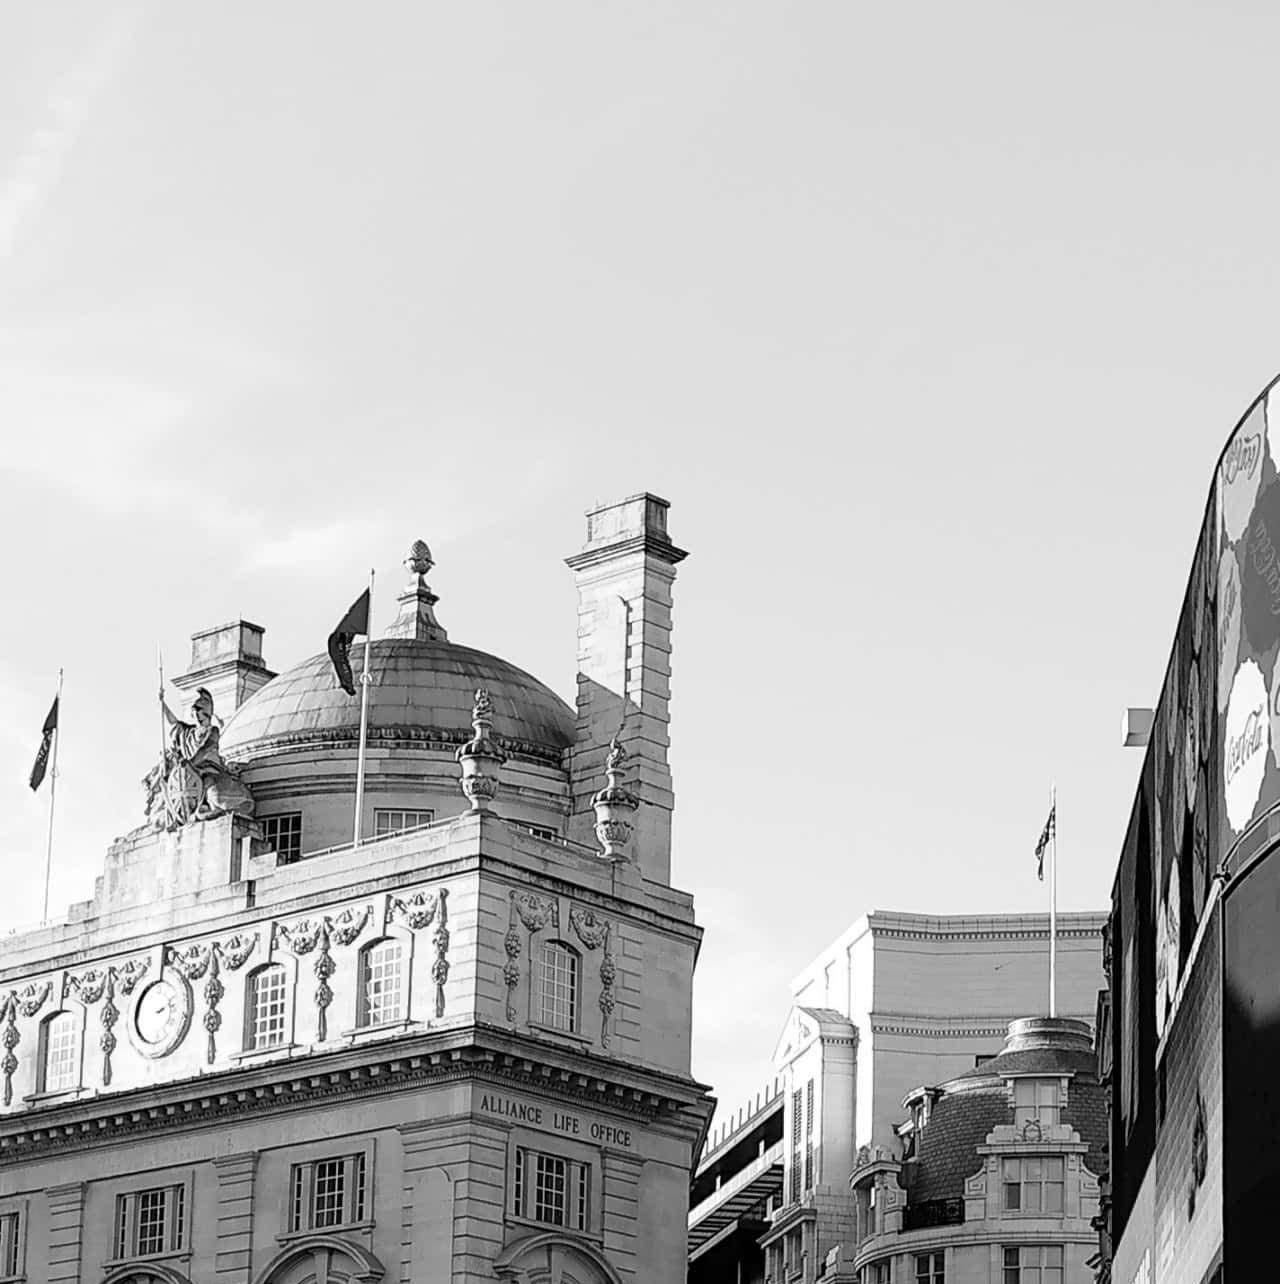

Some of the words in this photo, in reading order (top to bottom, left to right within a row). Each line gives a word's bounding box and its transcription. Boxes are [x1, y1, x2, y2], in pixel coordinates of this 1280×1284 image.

[480, 1095, 542, 1124] ALLIANCE
[554, 1113, 580, 1135] LIFE
[591, 1123, 632, 1147] OFFICE
